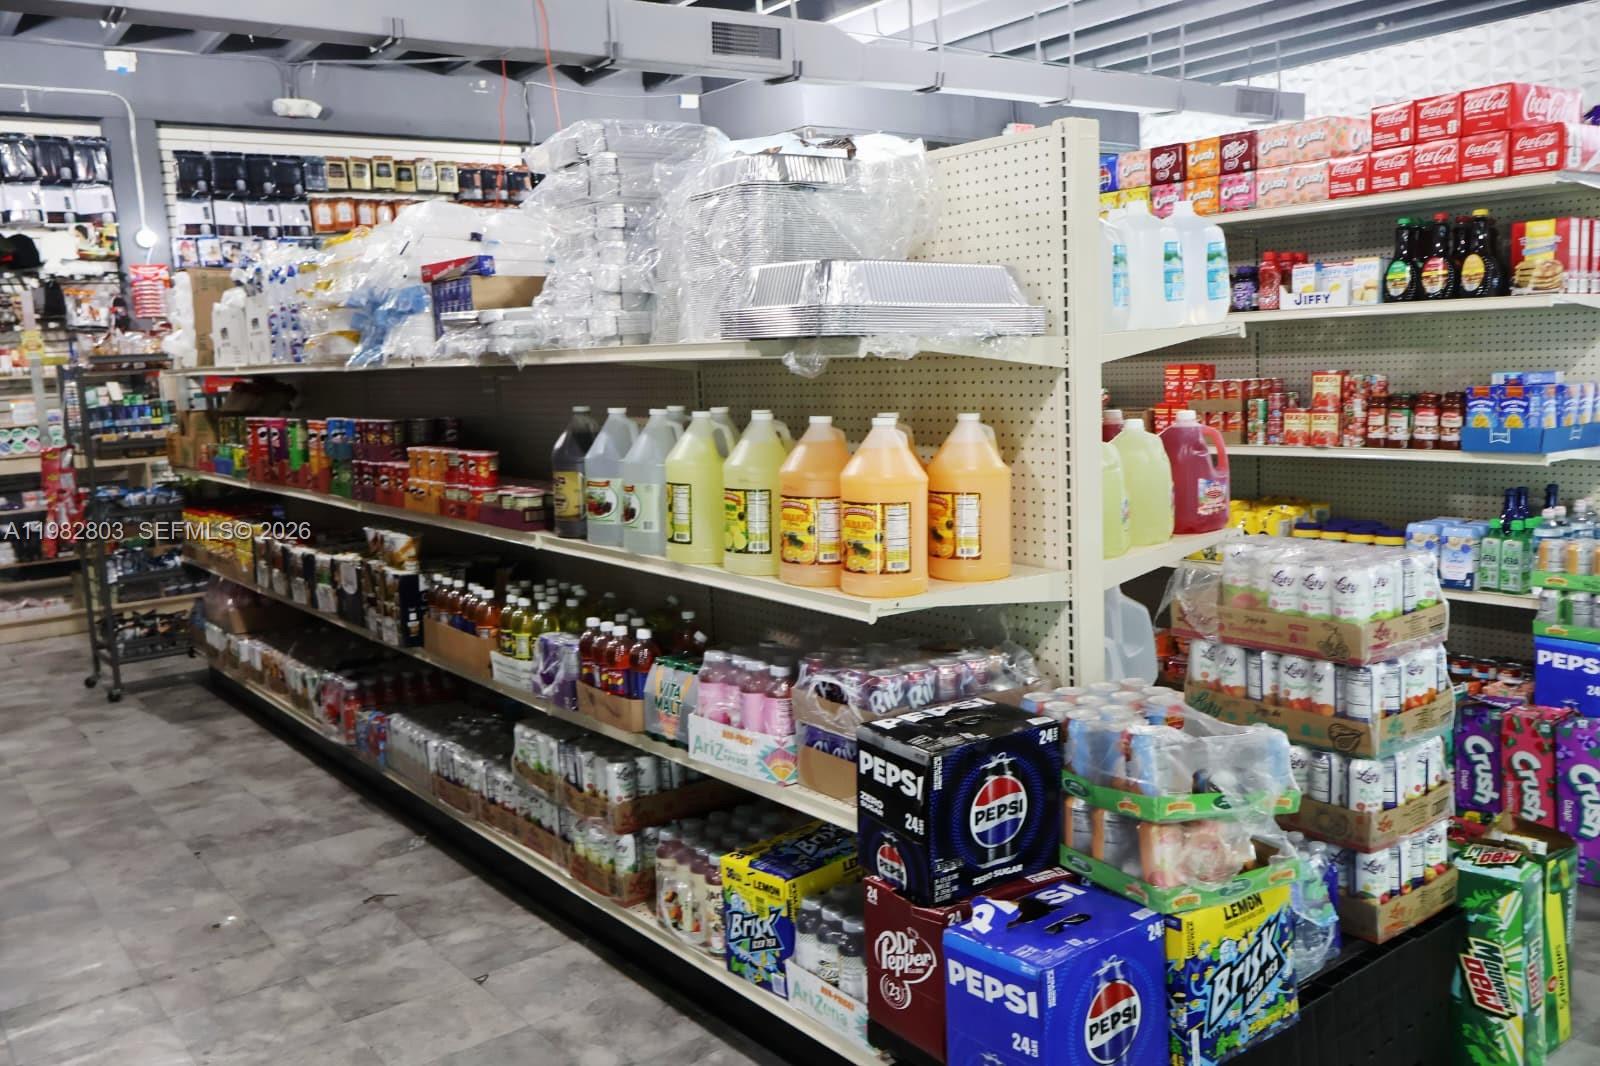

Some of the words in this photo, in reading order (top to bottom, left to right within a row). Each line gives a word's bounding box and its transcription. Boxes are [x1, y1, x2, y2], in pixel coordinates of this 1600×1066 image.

[1295, 294, 1331, 306] JIFFY
[1039, 728, 1053, 745] 24
[859, 750, 925, 801] PEPSI
[1464, 735, 1500, 804] Crush
[1512, 750, 1548, 822] Crush
[859, 791, 885, 810] ZERO
[905, 813, 919, 833] 24
[975, 799, 1024, 826] PEPSI
[972, 871, 993, 886] ZERO
[993, 864, 1024, 879] SUGAR
[754, 880, 780, 896] LEMON
[866, 886, 878, 899] 24
[1224, 892, 1263, 921] LEMON
[947, 911, 961, 927] 24
[896, 931, 917, 954] Dr
[1147, 921, 1164, 942] 24
[881, 932, 933, 977] Pepper
[889, 982, 901, 1001] 23
[947, 958, 1039, 1019] PEPSI
[1088, 1003, 1138, 1041] PEPSI
[1011, 1032, 1032, 1055] 24
